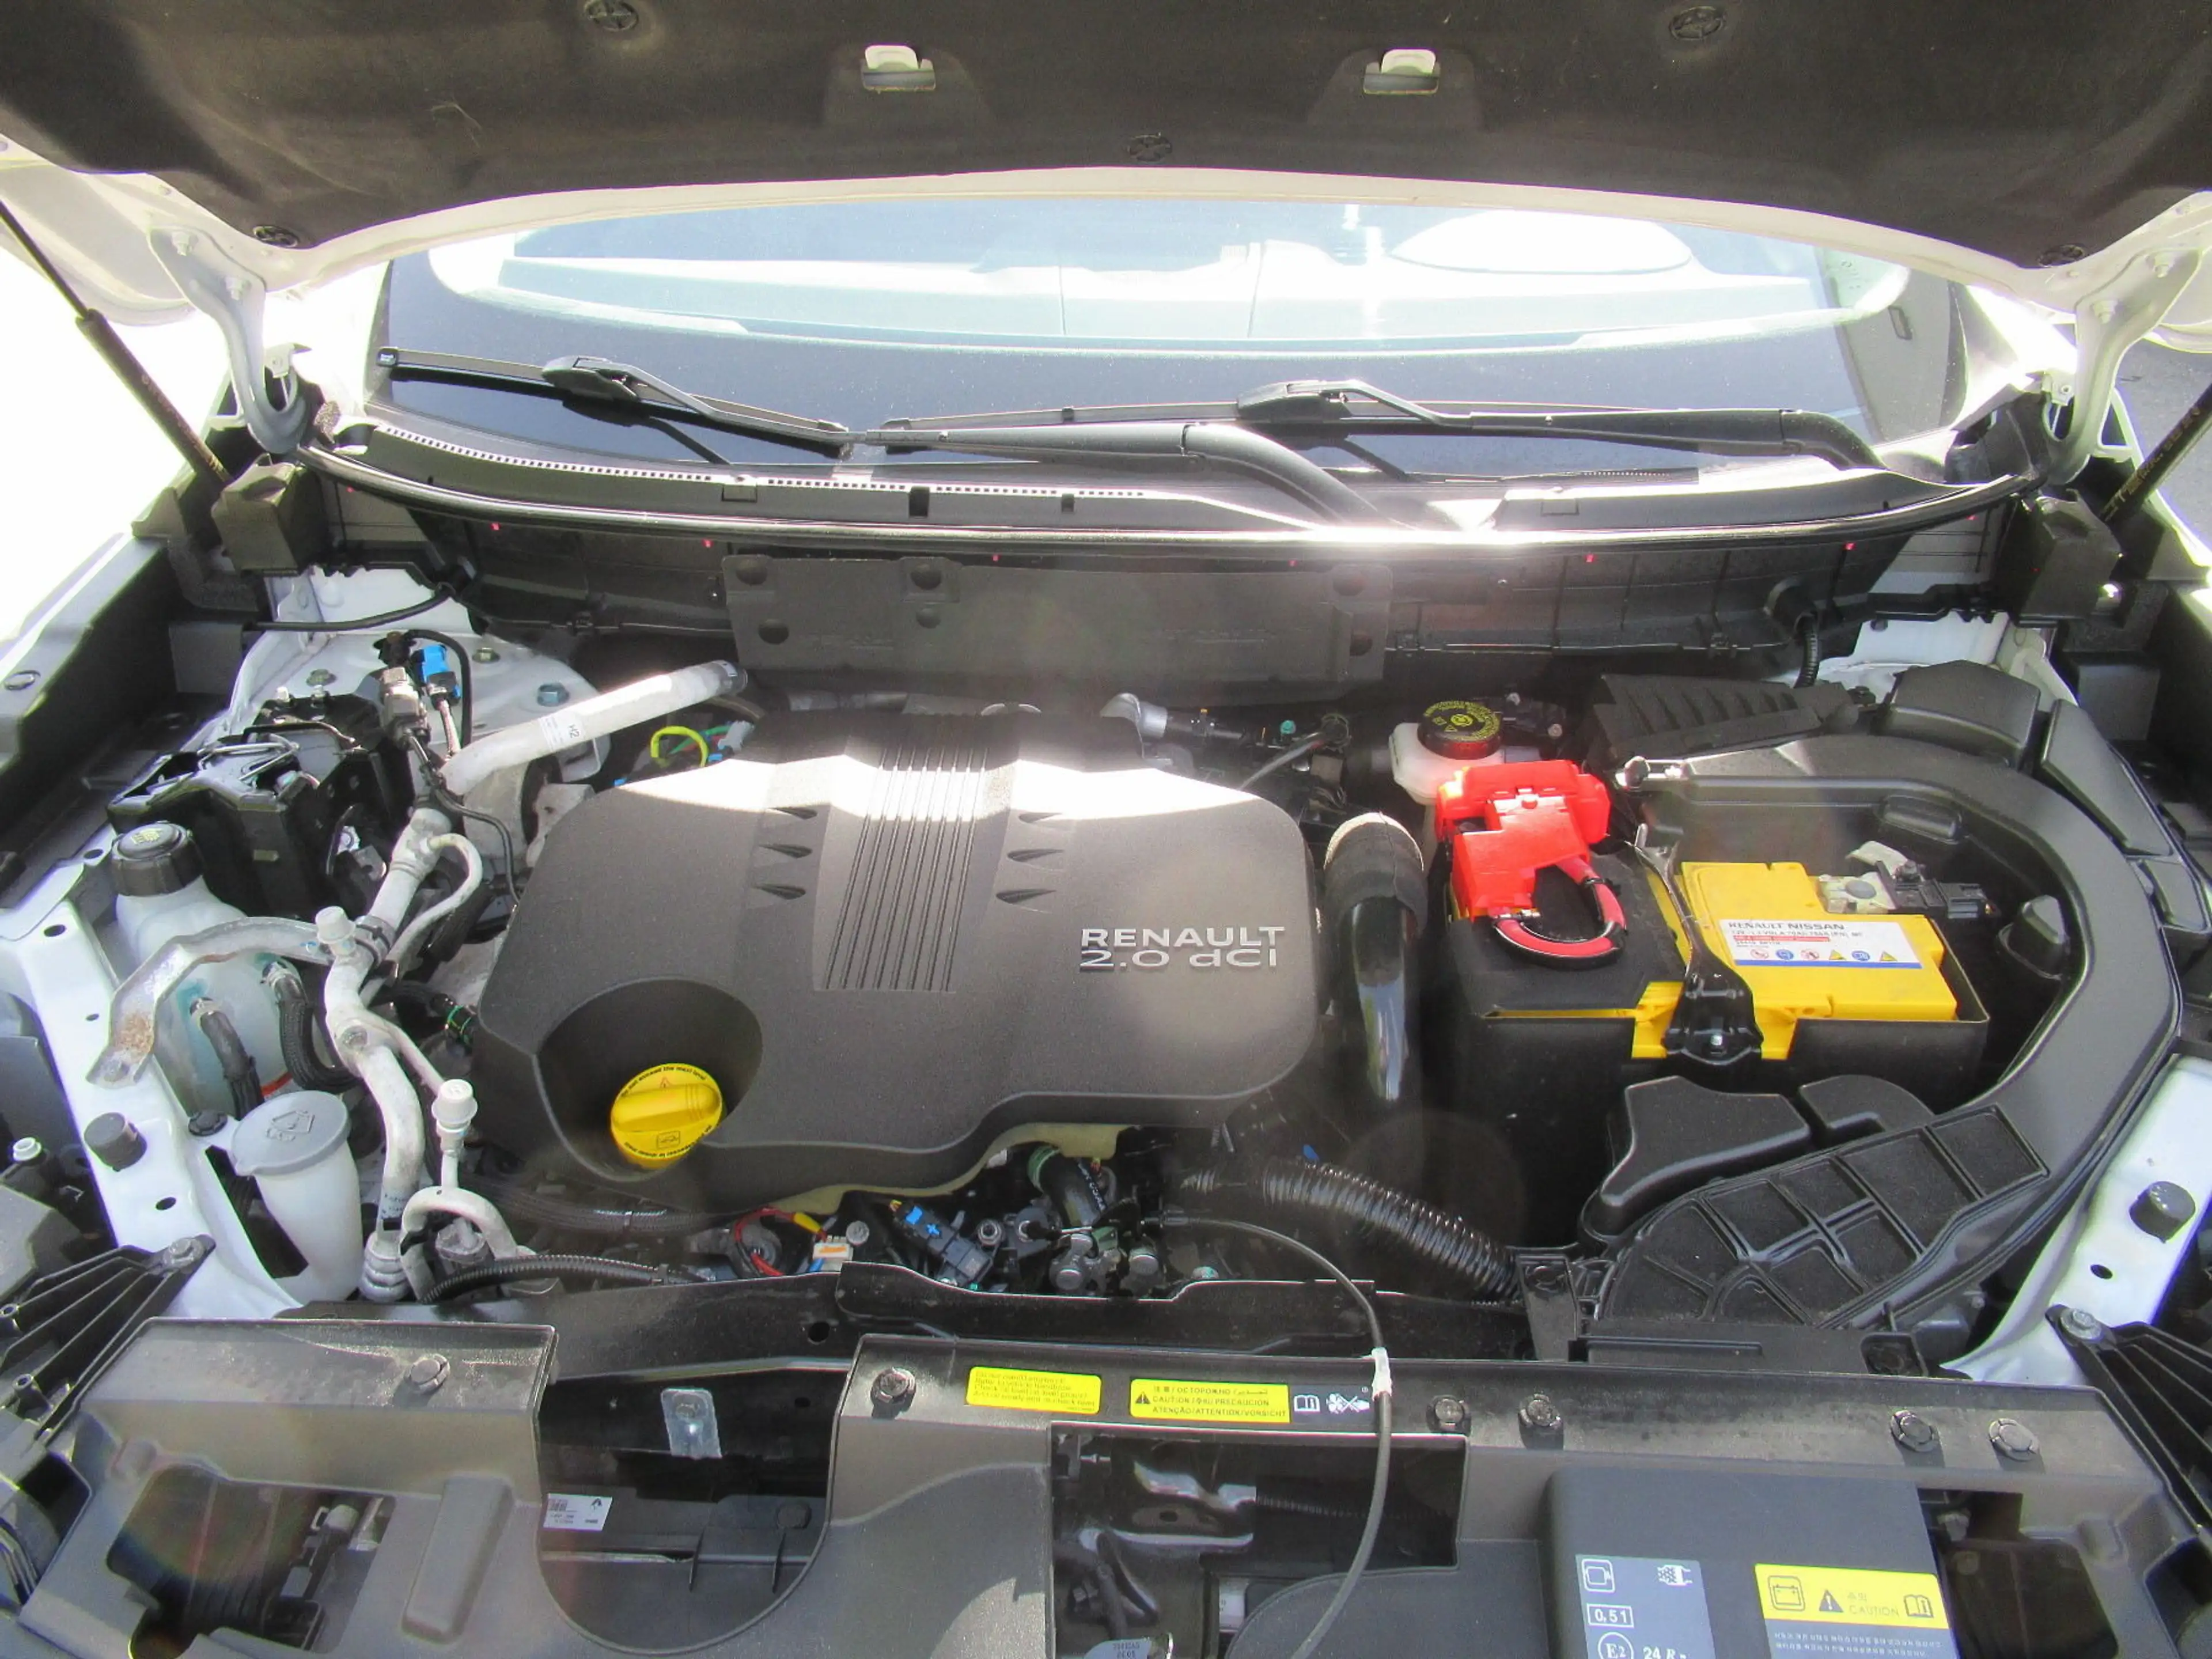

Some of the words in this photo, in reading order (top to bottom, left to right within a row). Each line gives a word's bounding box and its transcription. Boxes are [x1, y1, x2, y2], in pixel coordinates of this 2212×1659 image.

[1081, 926, 1286, 948] RENAULT
[1080, 949, 1170, 968] 2.0
[1849, 1605, 1900, 1617] CAUTION
